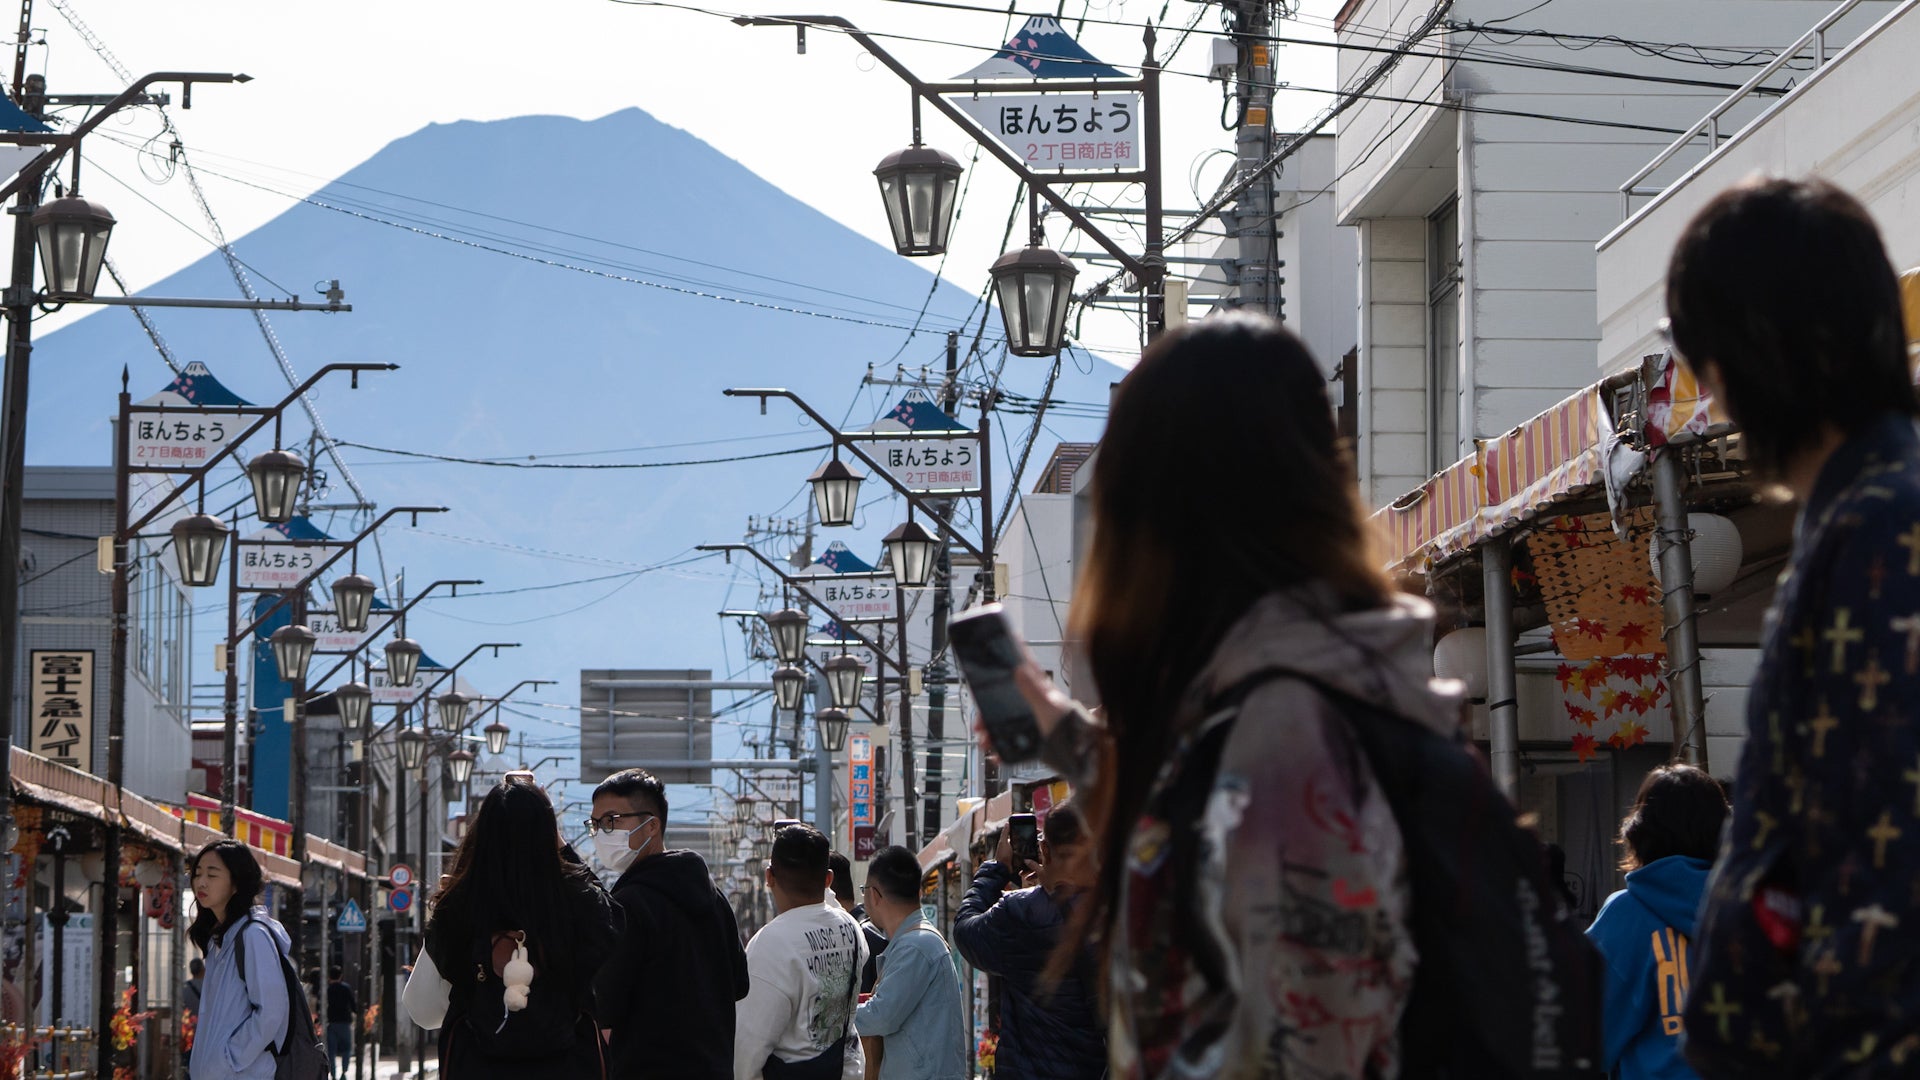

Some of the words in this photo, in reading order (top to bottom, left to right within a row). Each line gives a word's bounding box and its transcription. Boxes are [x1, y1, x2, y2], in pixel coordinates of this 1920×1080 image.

[1000, 102, 1131, 135] ほんちょう
[1027, 141, 1132, 161] 2丁目商店街
[138, 421, 225, 442] ほんちょう
[137, 446, 206, 459] 2丁目商店街
[888, 446, 972, 467] ほんちょう
[906, 471, 973, 483] 2丁目商店街
[245, 552, 313, 569] ほんちょう
[825, 584, 891, 602] ほんちょう
[805, 928, 836, 952] MUSIC
